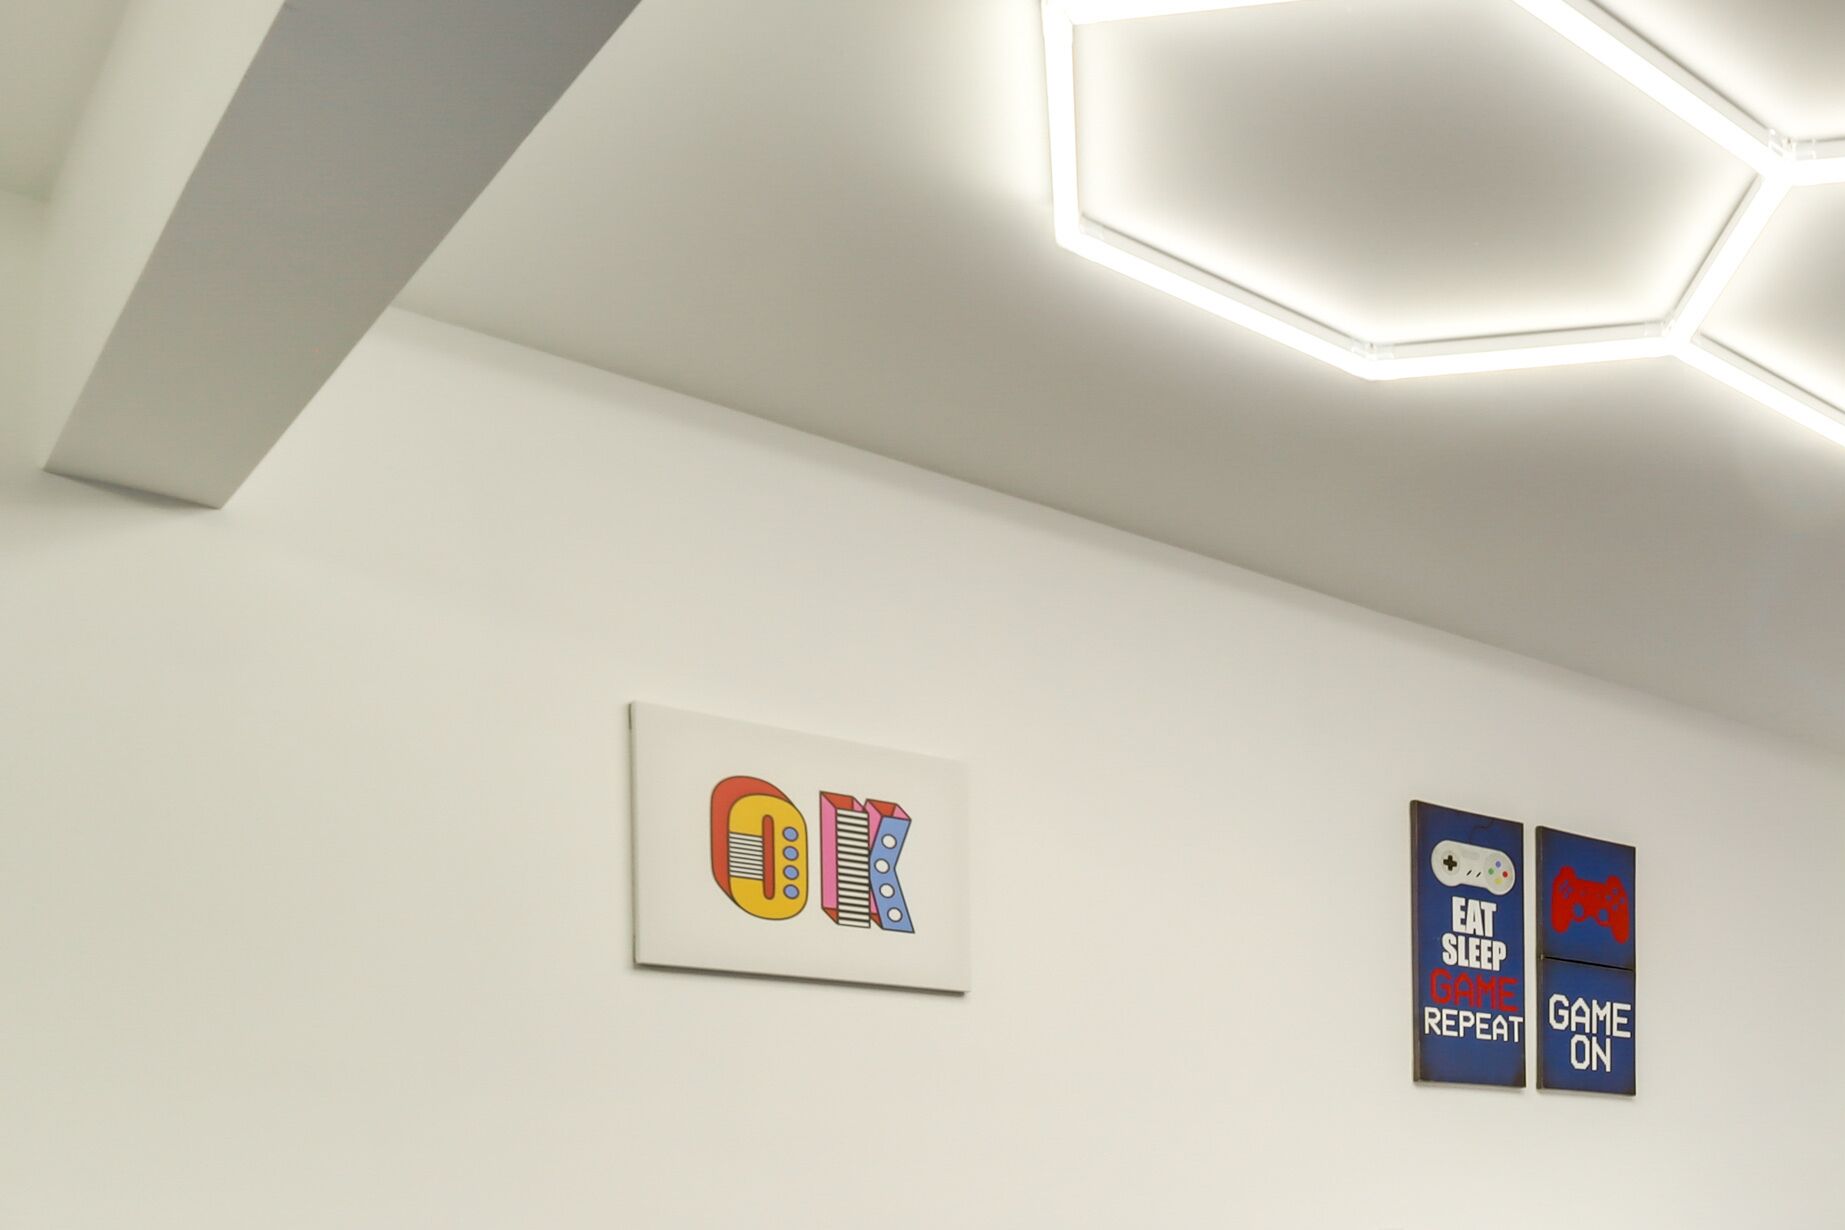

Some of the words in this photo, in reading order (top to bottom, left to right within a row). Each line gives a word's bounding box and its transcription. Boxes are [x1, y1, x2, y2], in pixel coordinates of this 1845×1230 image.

[710, 775, 915, 934] OK
[1451, 896, 1497, 938] EAT
[1441, 933, 1507, 972] SLEEP
[1430, 968, 1519, 1013] GAME
[1424, 1006, 1524, 1043] REPEAT
[1549, 993, 1632, 1039] GAME
[1570, 1034, 1612, 1073] ON
